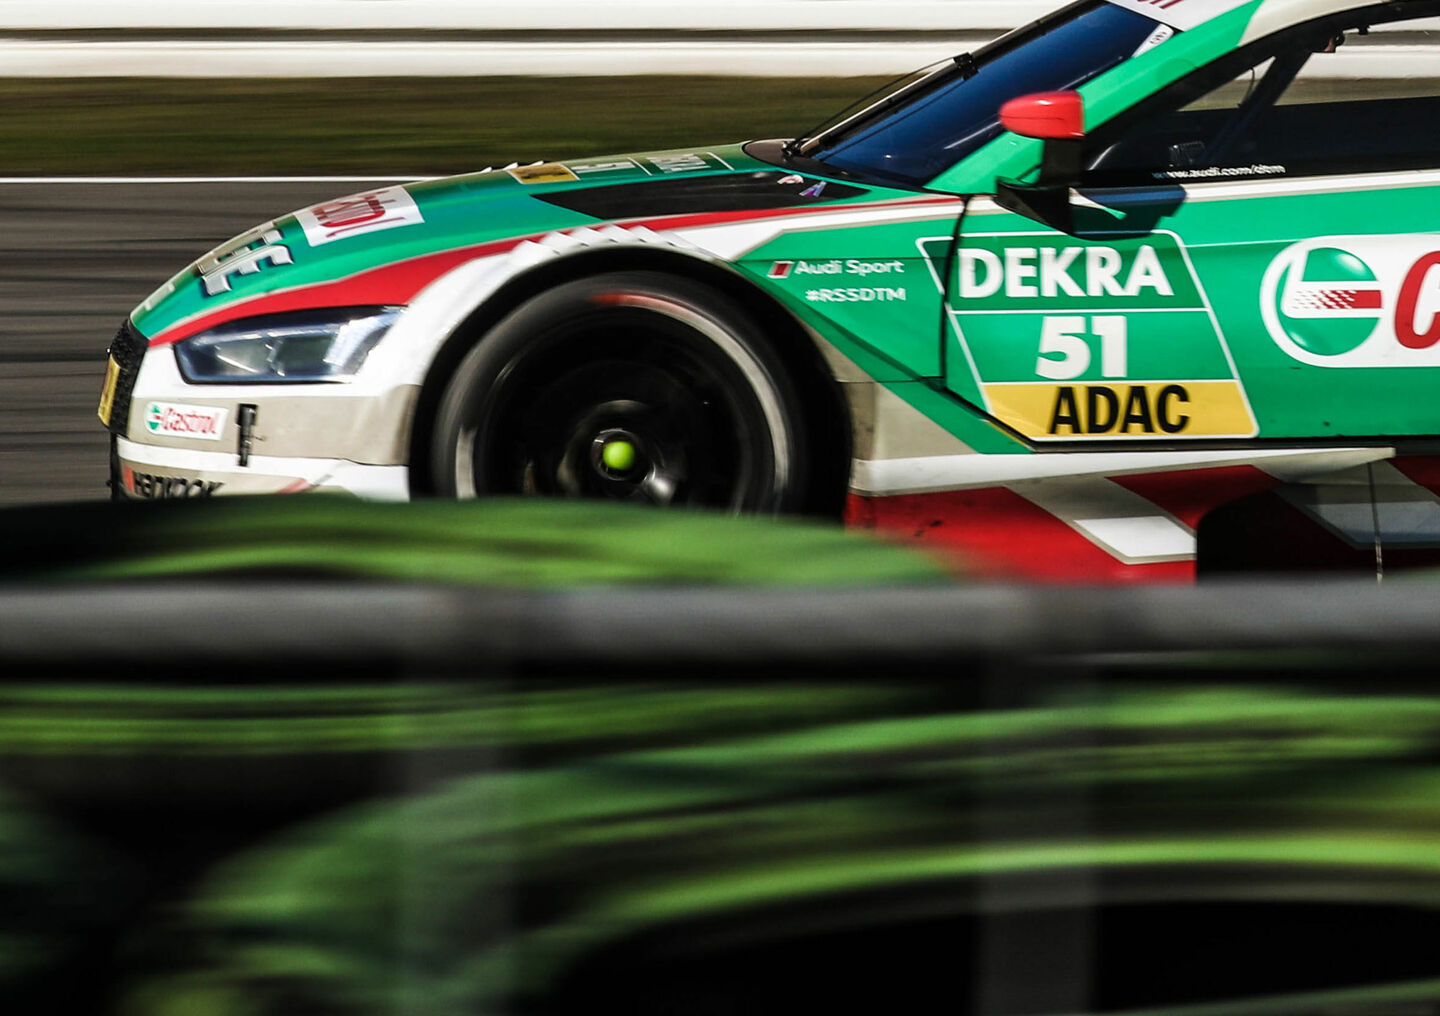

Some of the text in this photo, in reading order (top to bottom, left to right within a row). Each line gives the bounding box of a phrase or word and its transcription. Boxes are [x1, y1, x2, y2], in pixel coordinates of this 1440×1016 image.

[794, 260, 905, 277] Audi Sport
[957, 245, 1175, 299] DEKRA
[1035, 315, 1128, 380] 51
[1048, 384, 1192, 435] ADAC
